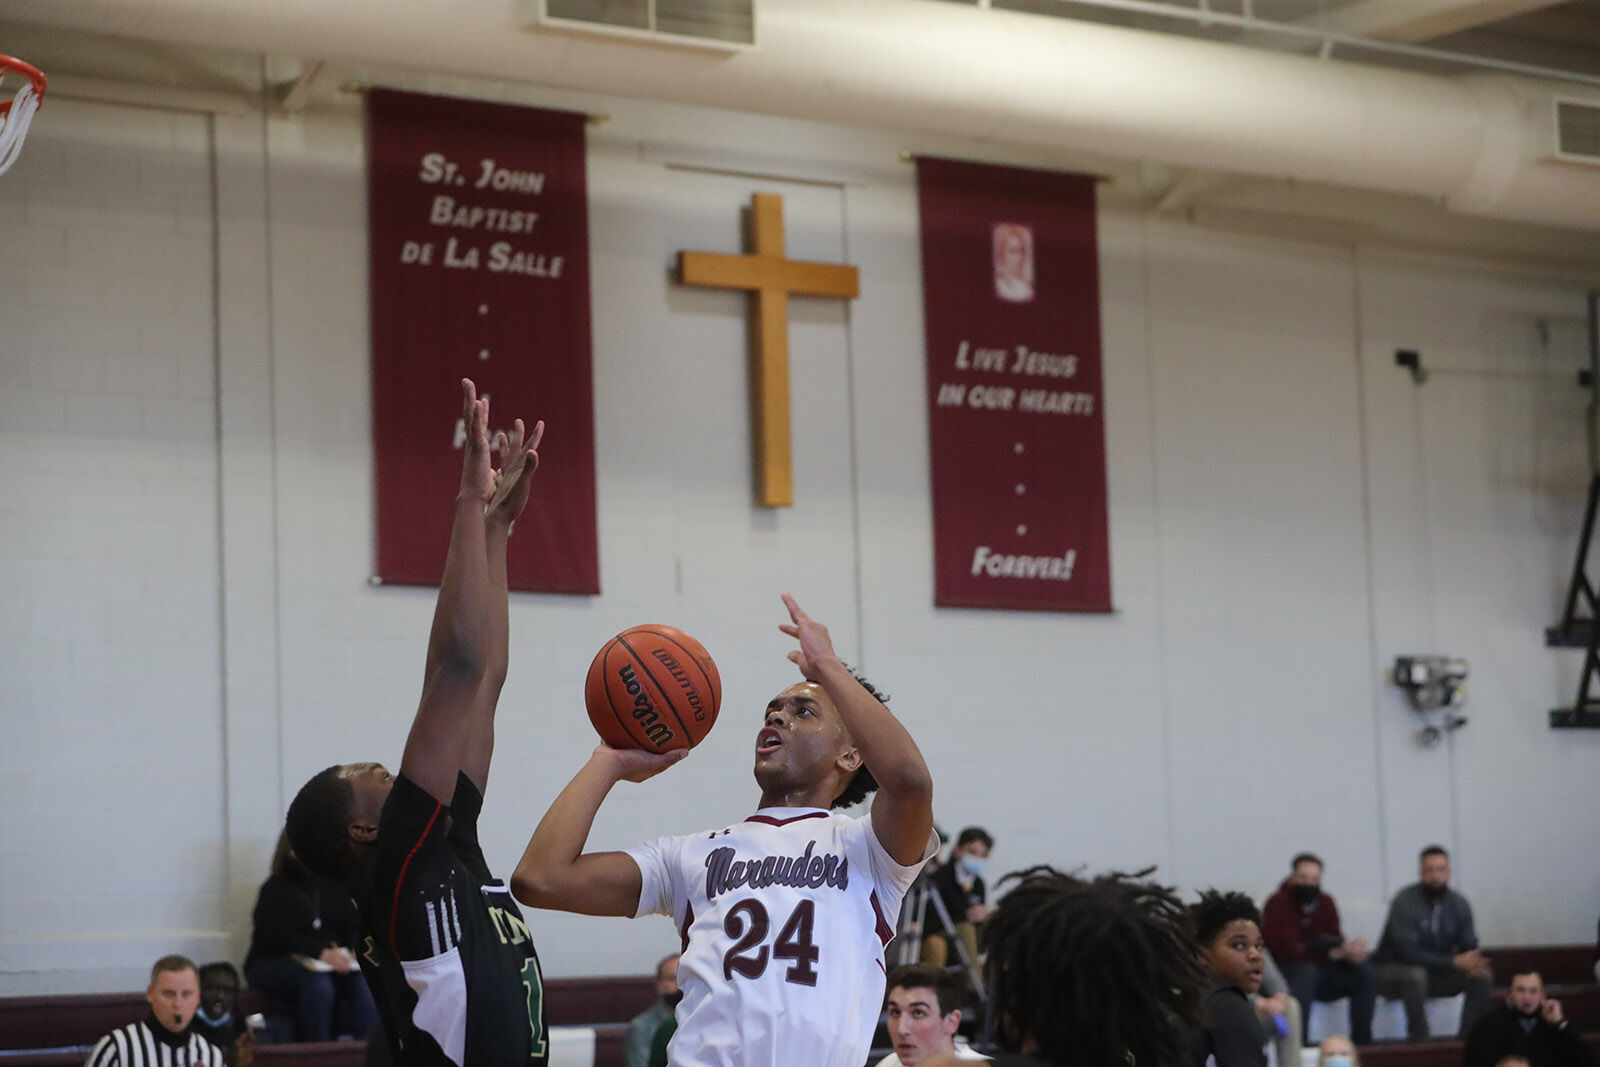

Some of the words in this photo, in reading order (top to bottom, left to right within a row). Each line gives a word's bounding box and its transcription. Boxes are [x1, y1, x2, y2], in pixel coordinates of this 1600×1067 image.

[618, 661, 675, 749] Wilson
[651, 647, 706, 723] EVOLUTION
[705, 840, 849, 901] Marauders
[723, 897, 820, 988] 24
